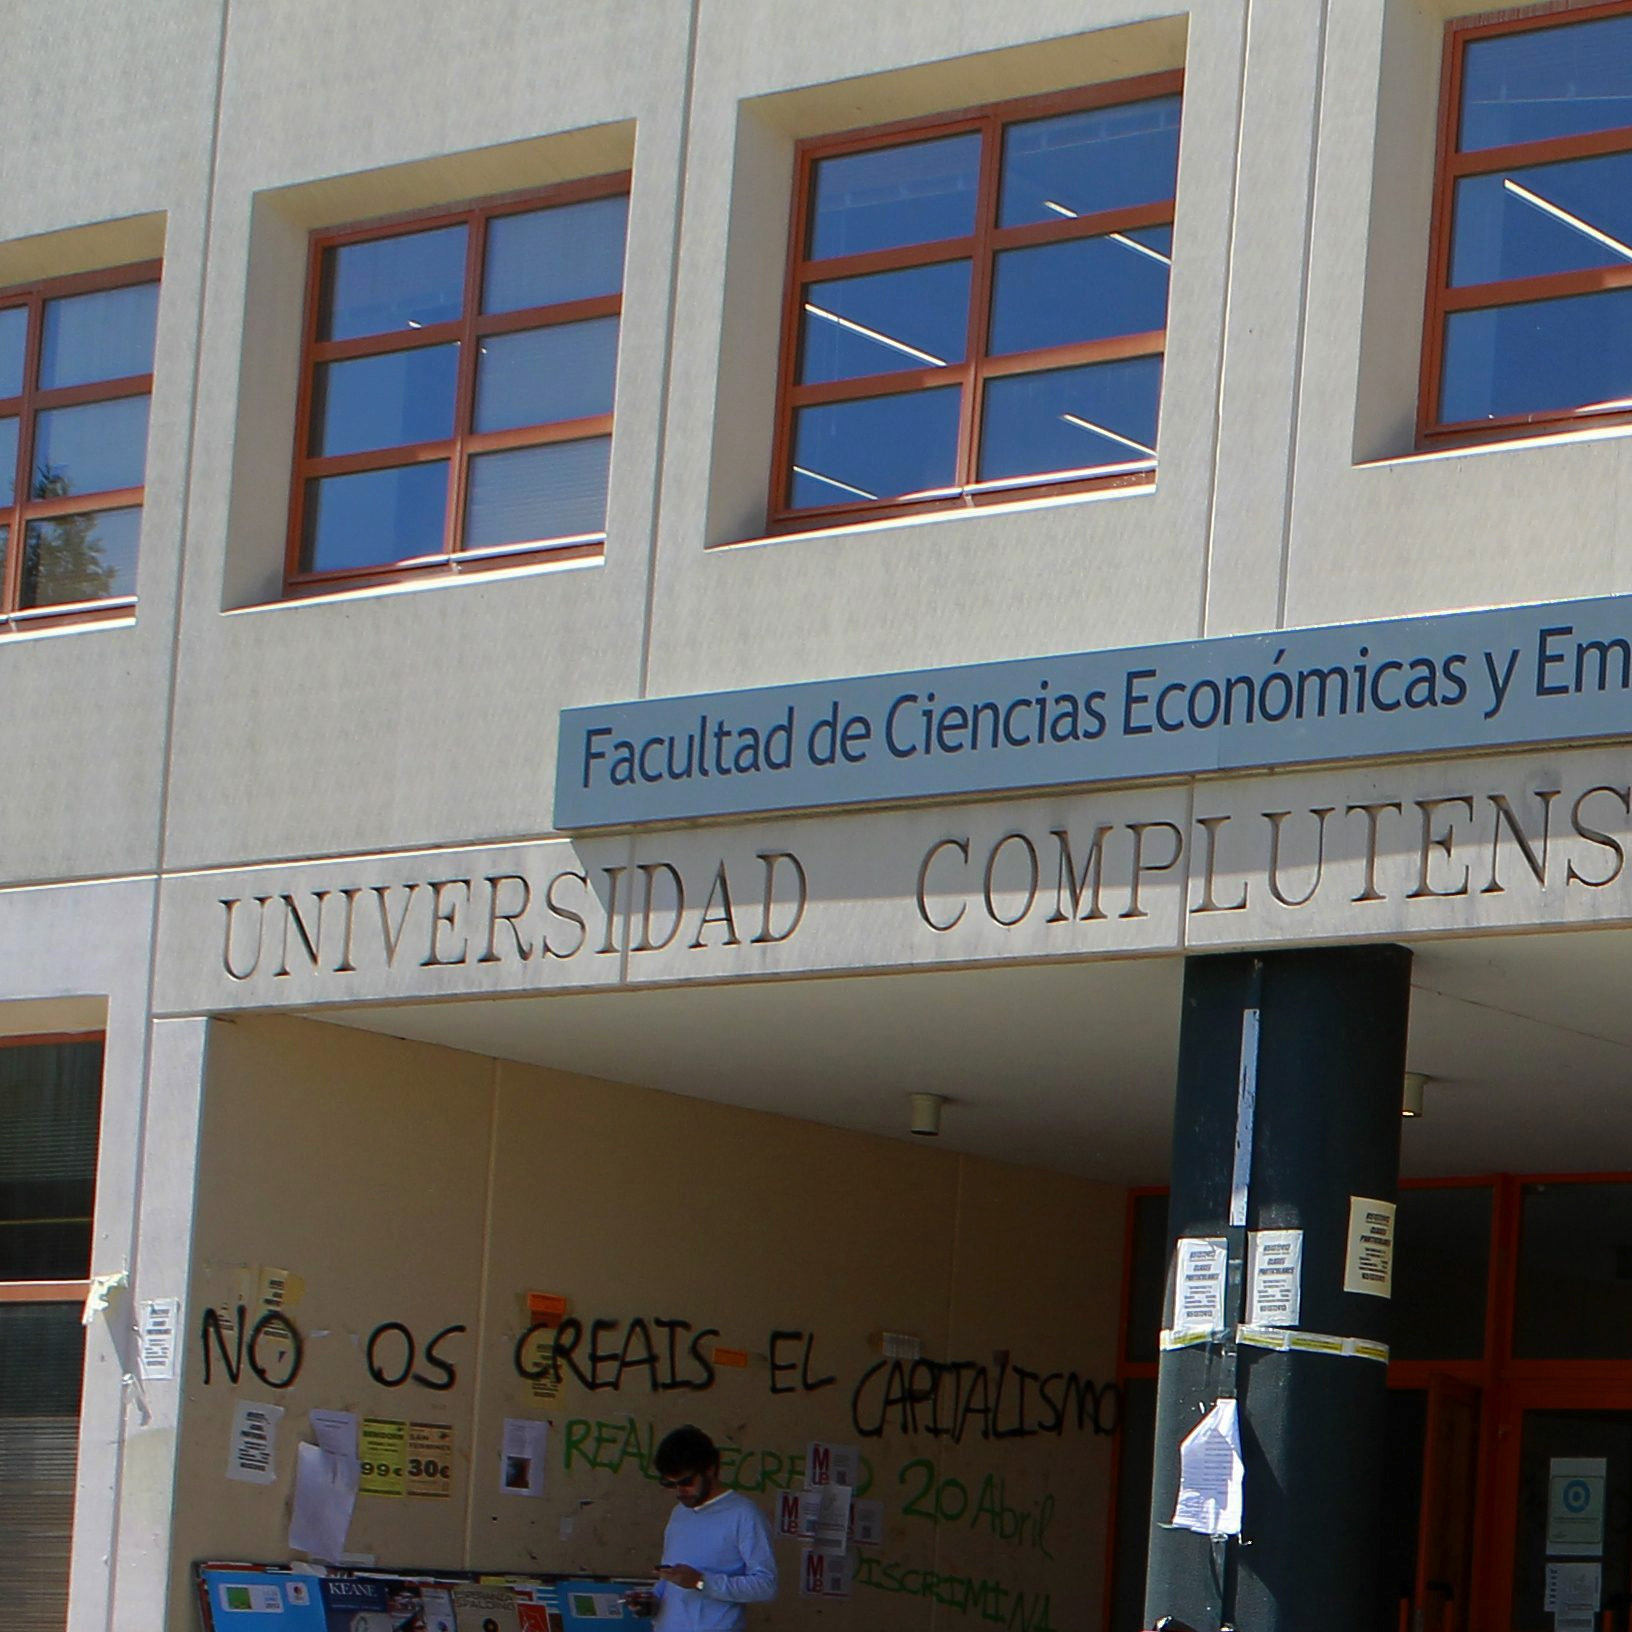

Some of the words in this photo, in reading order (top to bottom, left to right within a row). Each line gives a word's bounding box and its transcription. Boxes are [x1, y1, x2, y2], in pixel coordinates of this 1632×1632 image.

[582, 705, 795, 789] Facultad
[807, 700, 872, 766] de
[884, 680, 1106, 760] Ciencias
[1123, 649, 1468, 737] Económicas
[1483, 647, 1520, 719] y
[218, 851, 809, 981] UNIVERSIDAD
[202, 1305, 301, 1389] NO
[367, 1322, 465, 1389] OS
[515, 1316, 721, 1391] CREAIS
[769, 1331, 836, 1394] EL
[852, 1356, 1121, 1444] CAPITALISMO
[564, 1415, 662, 1483] REAL
[897, 1458, 968, 1523] 20
[970, 1472, 1055, 1561] Abril
[328, 1582, 377, 1598] KEANE
